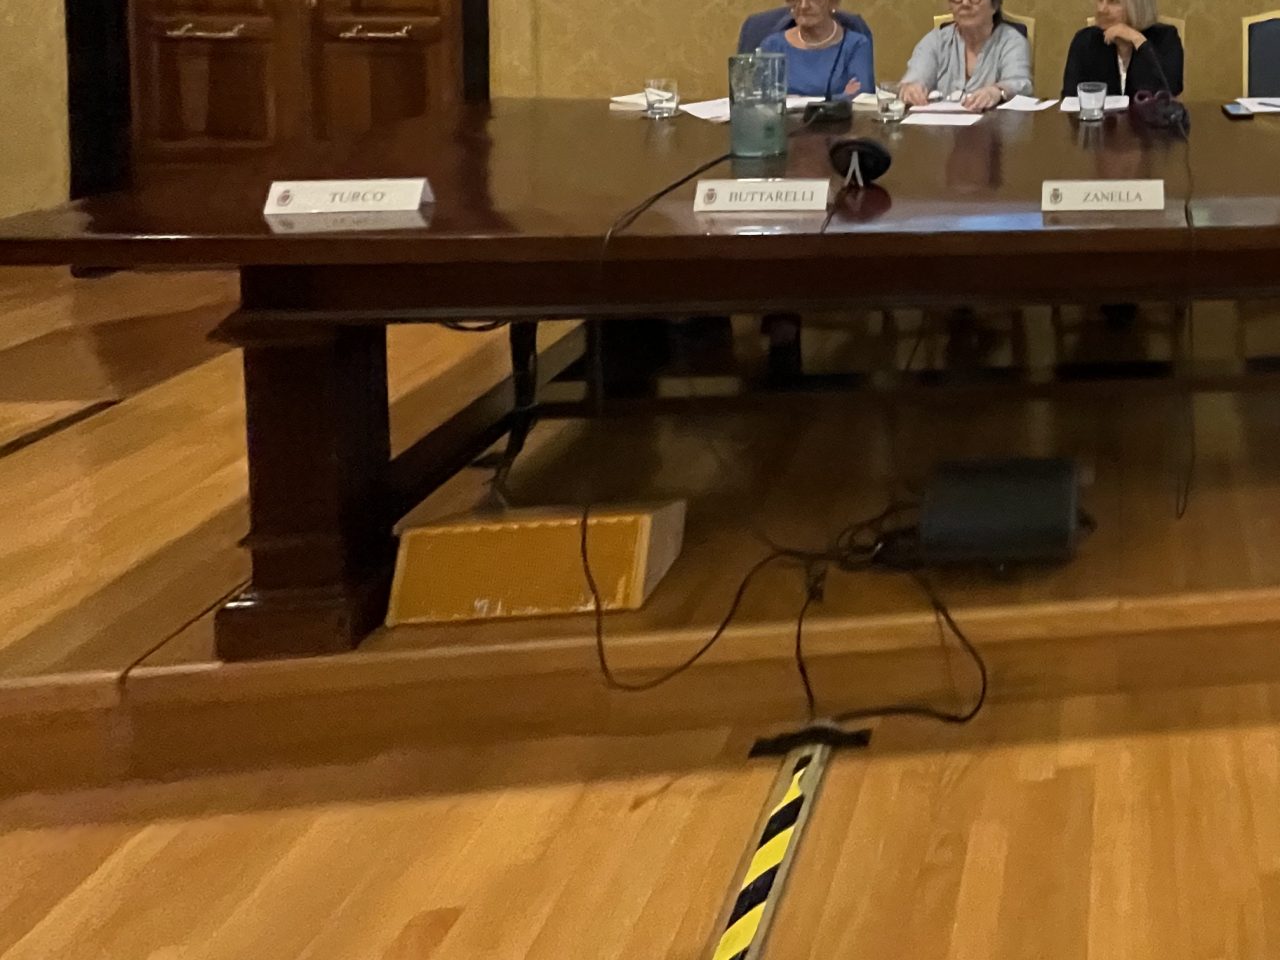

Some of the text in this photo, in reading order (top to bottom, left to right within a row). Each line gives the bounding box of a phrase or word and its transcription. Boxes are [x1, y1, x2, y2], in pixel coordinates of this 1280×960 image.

[329, 191, 386, 204] TURCO
[728, 191, 815, 203] BUTTARELLI
[1082, 191, 1143, 203] ZANELLA
